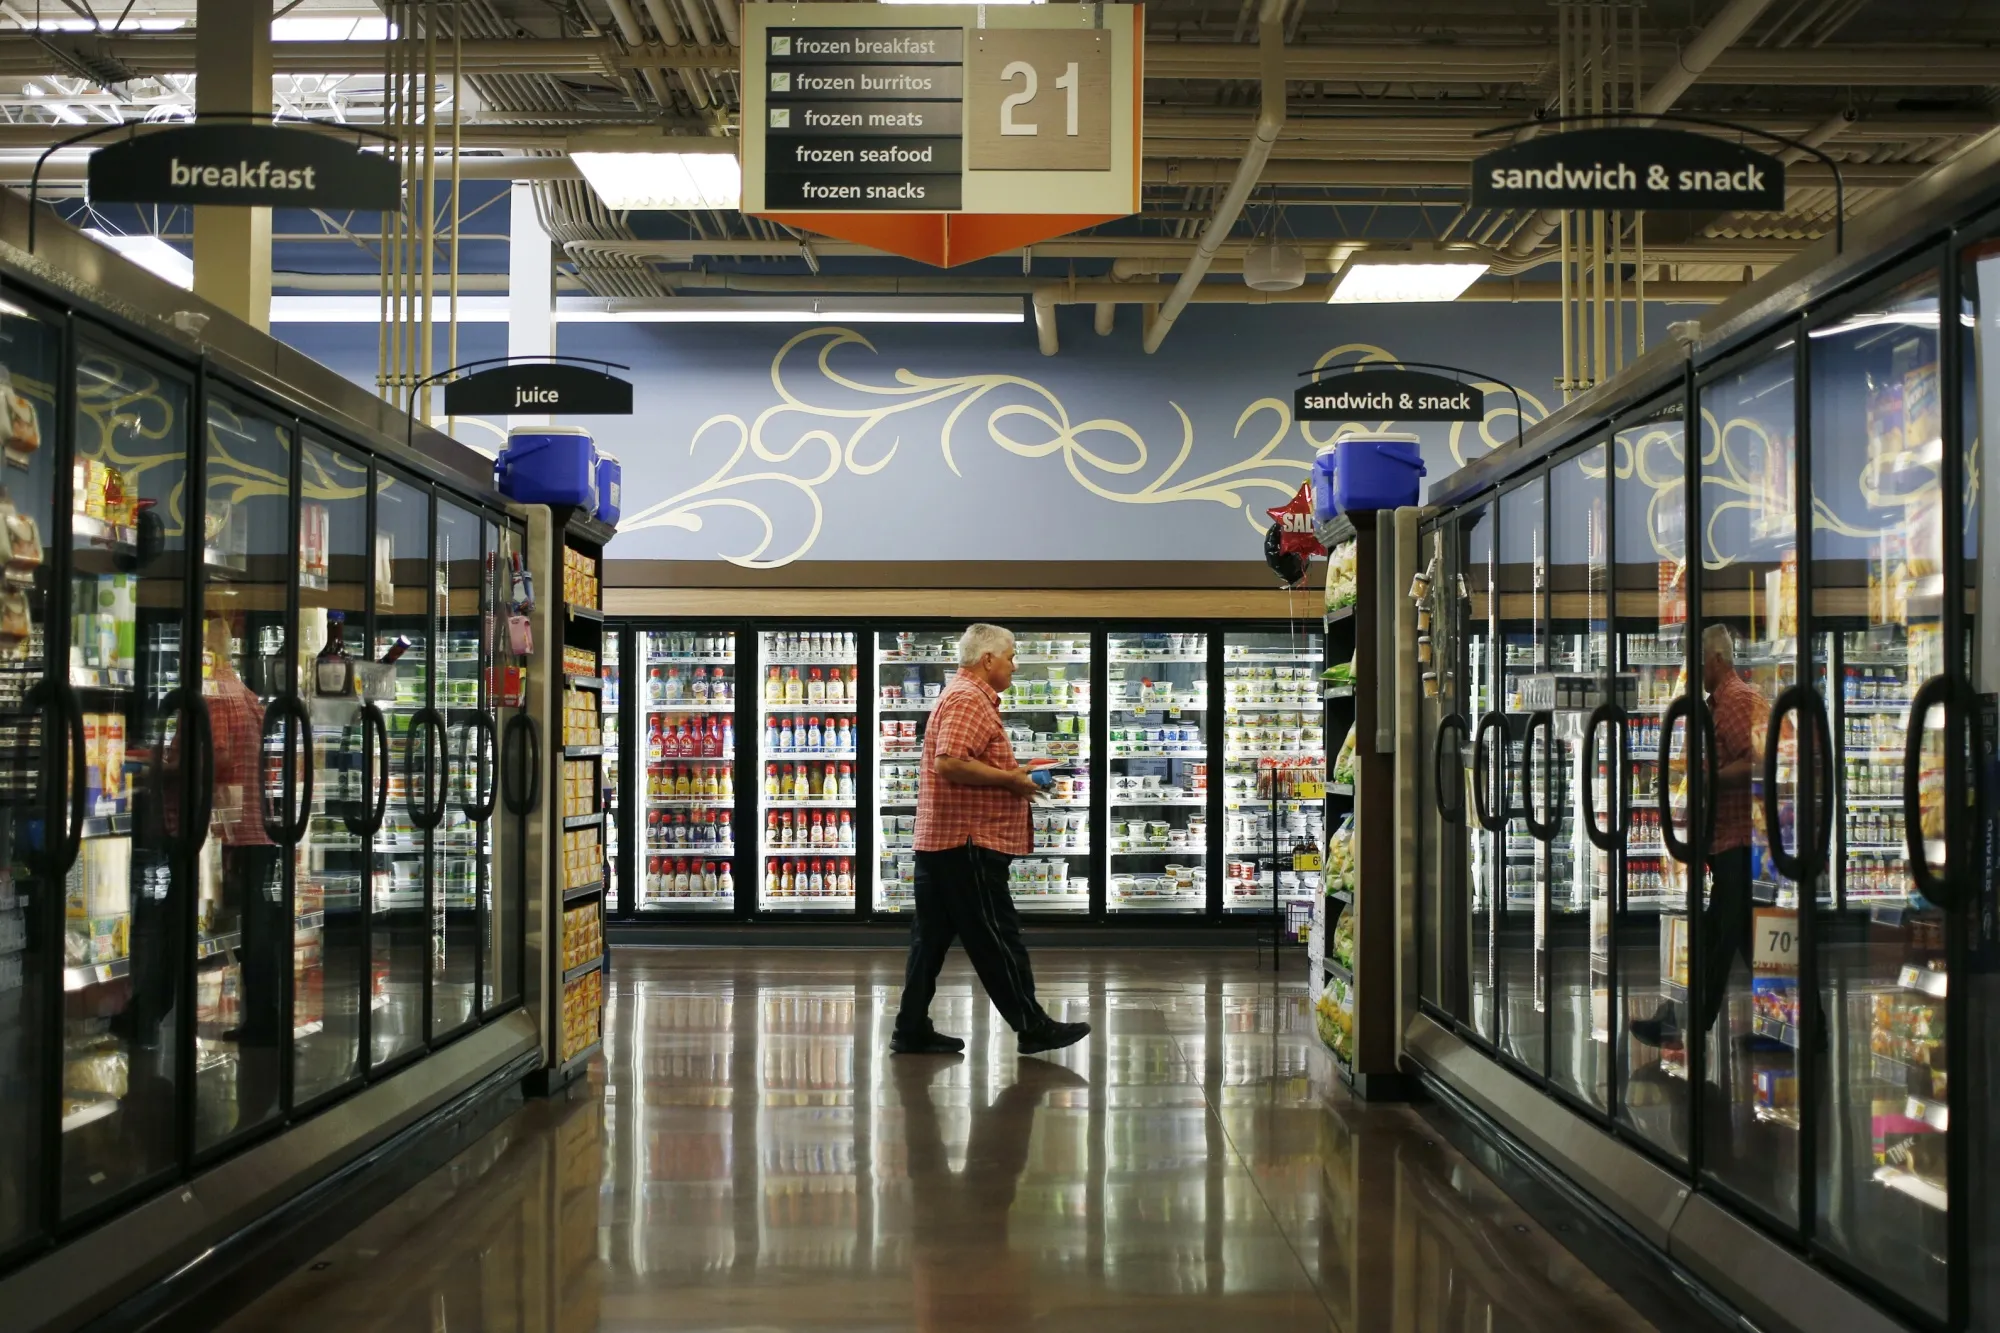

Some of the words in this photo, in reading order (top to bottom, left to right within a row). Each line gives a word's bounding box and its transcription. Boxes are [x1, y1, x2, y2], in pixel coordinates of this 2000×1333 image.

[795, 38, 851, 54] frozen
[855, 38, 935, 55] breakfast
[796, 74, 855, 90] frozen
[861, 74, 932, 91] burritos
[1000, 60, 1079, 136] 21
[804, 110, 863, 126] frozen
[868, 111, 923, 127] meats
[795, 146, 854, 162] frozen
[859, 146, 932, 163] seafood
[171, 158, 316, 190] breakfast
[1491, 162, 1636, 190] sandwich
[1646, 164, 1670, 190] &
[1678, 163, 1765, 191] snack
[802, 182, 861, 199] frozen
[866, 182, 925, 199] snacks
[515, 386, 559, 407] juice
[1304, 392, 1393, 410] sandwich
[1398, 393, 1413, 410] &
[1418, 392, 1471, 410] snack
[1282, 512, 1314, 533] SAL
